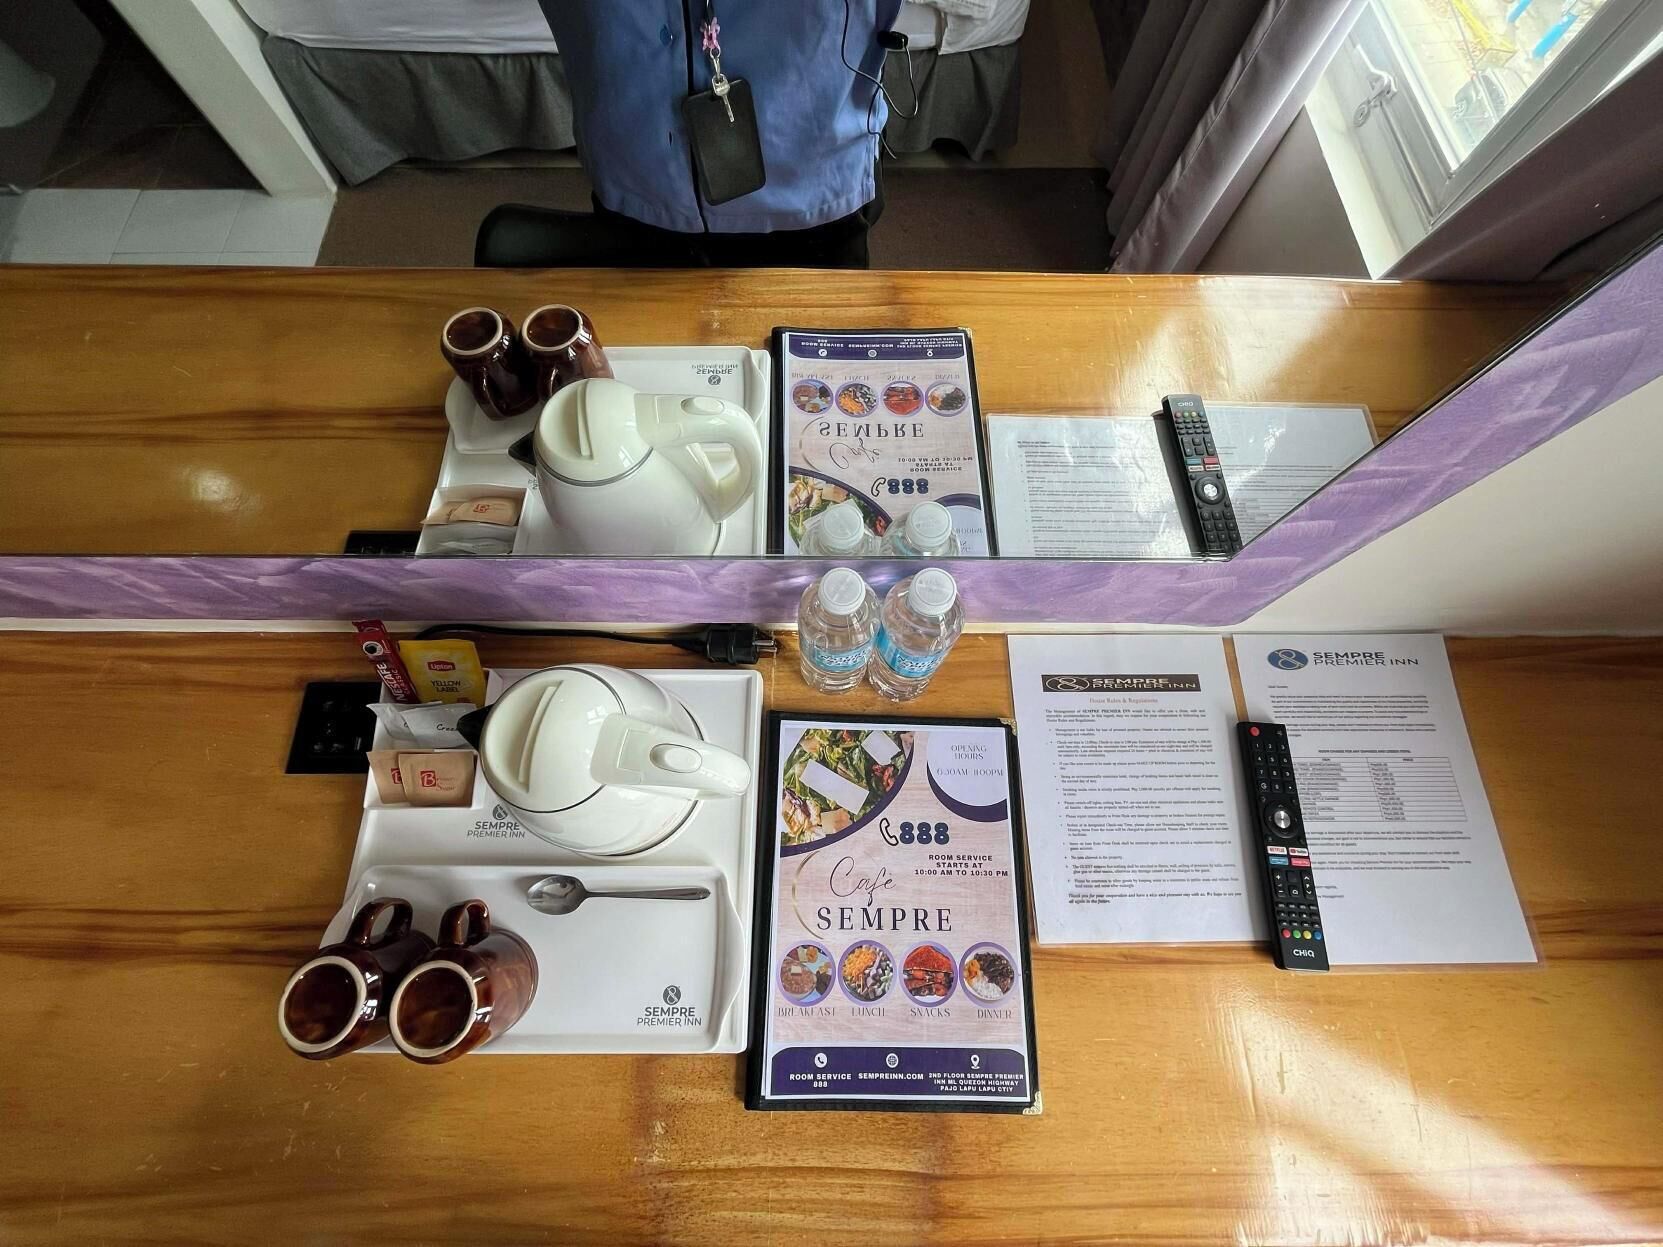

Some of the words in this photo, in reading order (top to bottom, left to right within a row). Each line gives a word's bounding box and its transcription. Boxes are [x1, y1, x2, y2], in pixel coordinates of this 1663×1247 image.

[1312, 651, 1385, 659] SEMPRE
[1313, 658, 1386, 666] PREMIER
[950, 744, 987, 752] OPENING
[954, 752, 984, 760] HOURS
[474, 820, 520, 831] SEMPRE
[467, 829, 508, 838] PREMIER
[509, 830, 526, 838] INN
[899, 821, 950, 845] 888
[956, 854, 993, 862] SERVICE
[936, 861, 969, 869] STARTS
[817, 906, 953, 932] SEMPRE
[1292, 948, 1315, 958] CHiQ
[644, 1006, 696, 1018] SEMPRE
[778, 1007, 836, 1017] BREAKFAST
[851, 1007, 886, 1017] LUNCH
[910, 1007, 951, 1017] SNACKS
[977, 1009, 1012, 1019] DINNER
[637, 1017, 682, 1027] PREMIER
[684, 1017, 702, 1026] INN
[789, 1073, 814, 1081] ROOM
[858, 1072, 924, 1080] SEMPREINN.COM
[813, 1080, 828, 1088] 888
